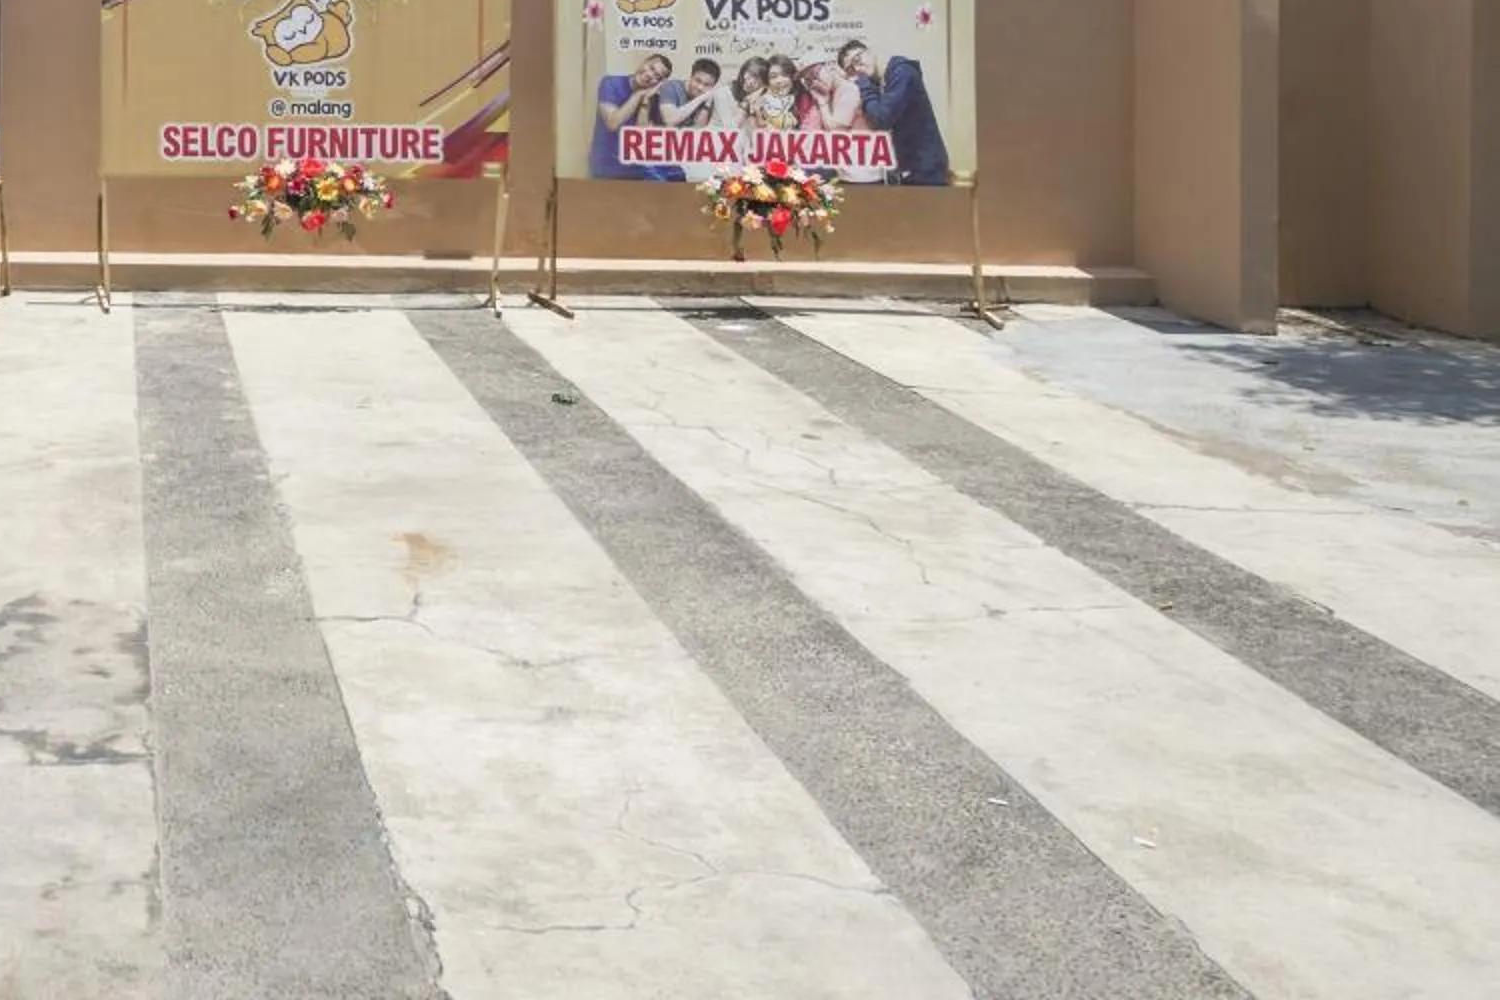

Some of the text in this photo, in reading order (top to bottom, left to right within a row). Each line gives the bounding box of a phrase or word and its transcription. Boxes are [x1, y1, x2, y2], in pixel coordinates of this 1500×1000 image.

[643, 16, 673, 28] PODS
[695, 43, 723, 55] milk
[273, 71, 345, 87] VK PODS
[292, 100, 351, 117] malang
[163, 126, 441, 159] SELCO FURNITURE
[623, 130, 892, 166] REMAX JAKARTA
